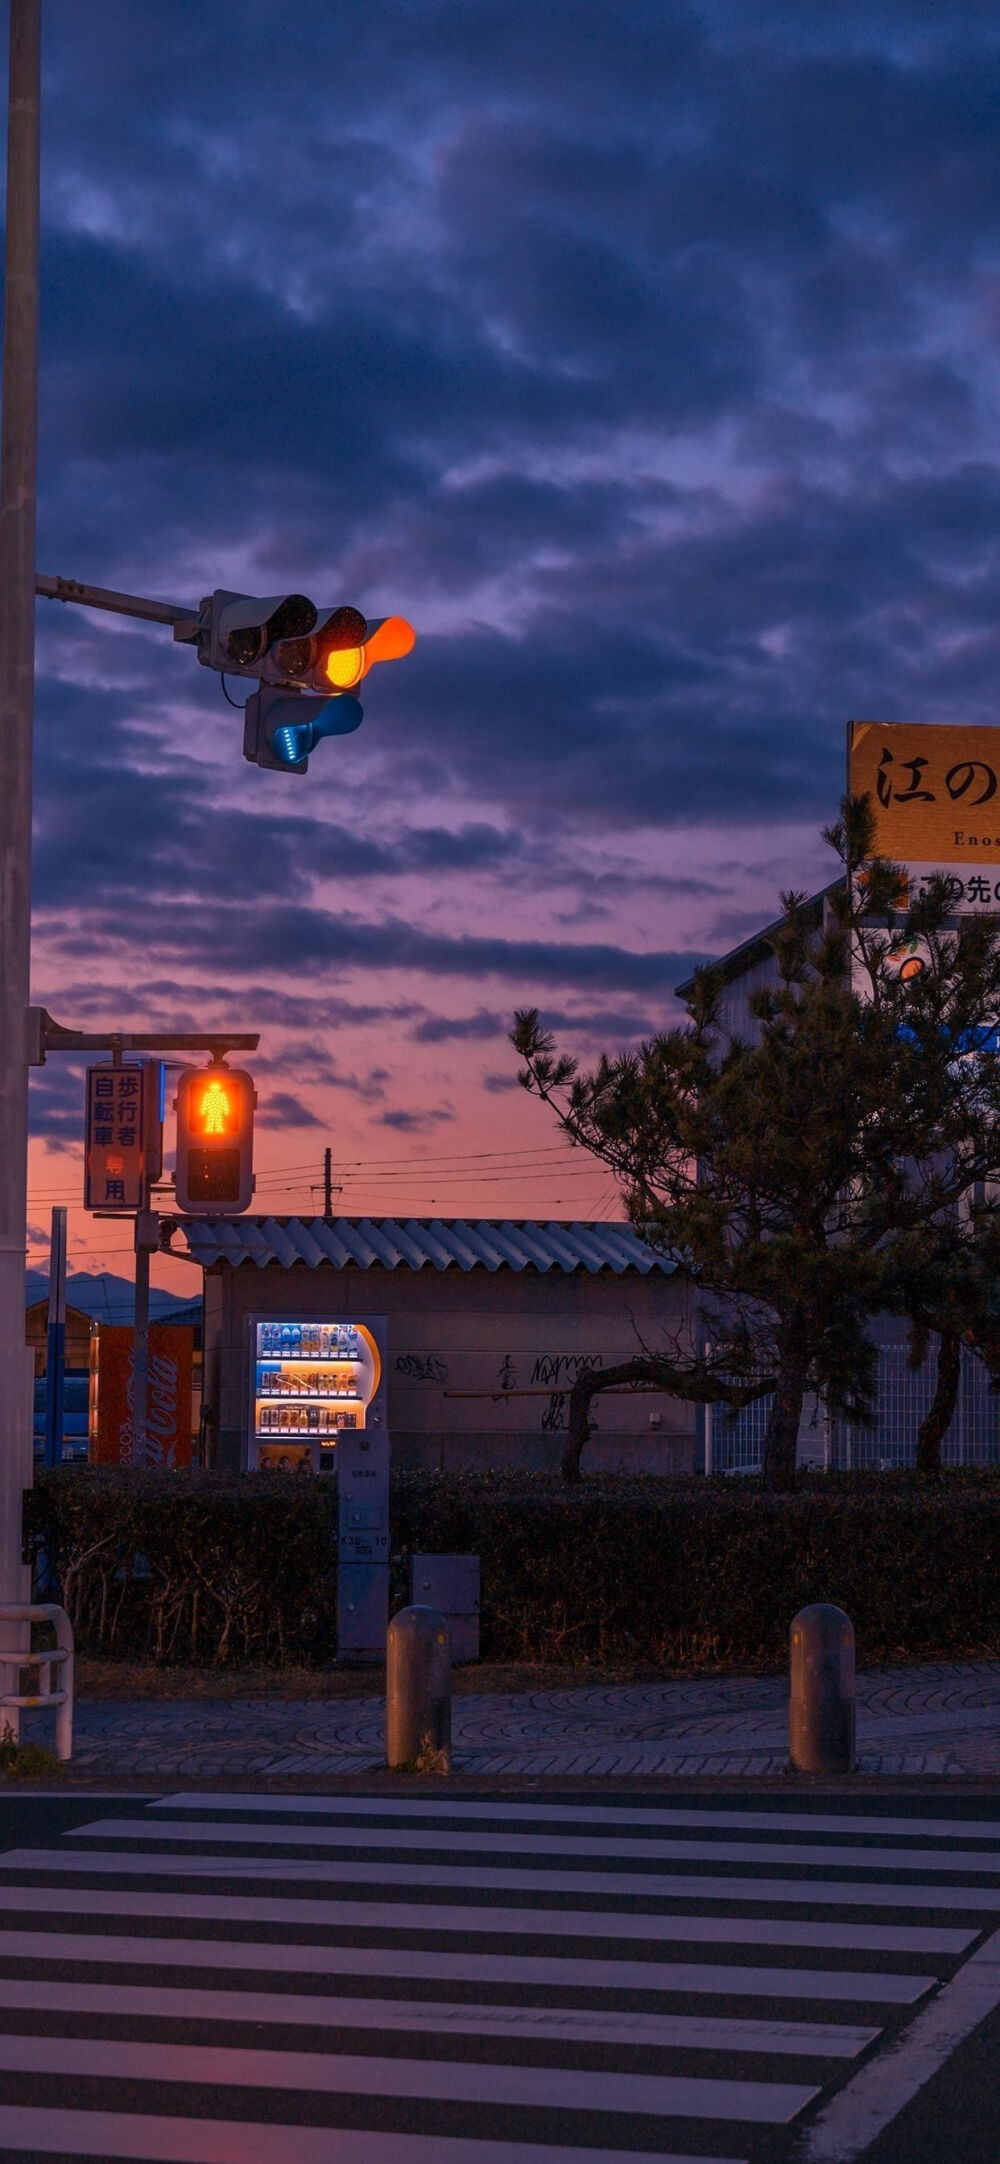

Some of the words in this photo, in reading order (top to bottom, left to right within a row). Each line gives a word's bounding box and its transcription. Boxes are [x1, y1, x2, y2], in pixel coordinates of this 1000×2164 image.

[877, 747, 998, 809] 江の
[94, 1076, 114, 1148] 自転車
[117, 1076, 138, 1147] 歩行者
